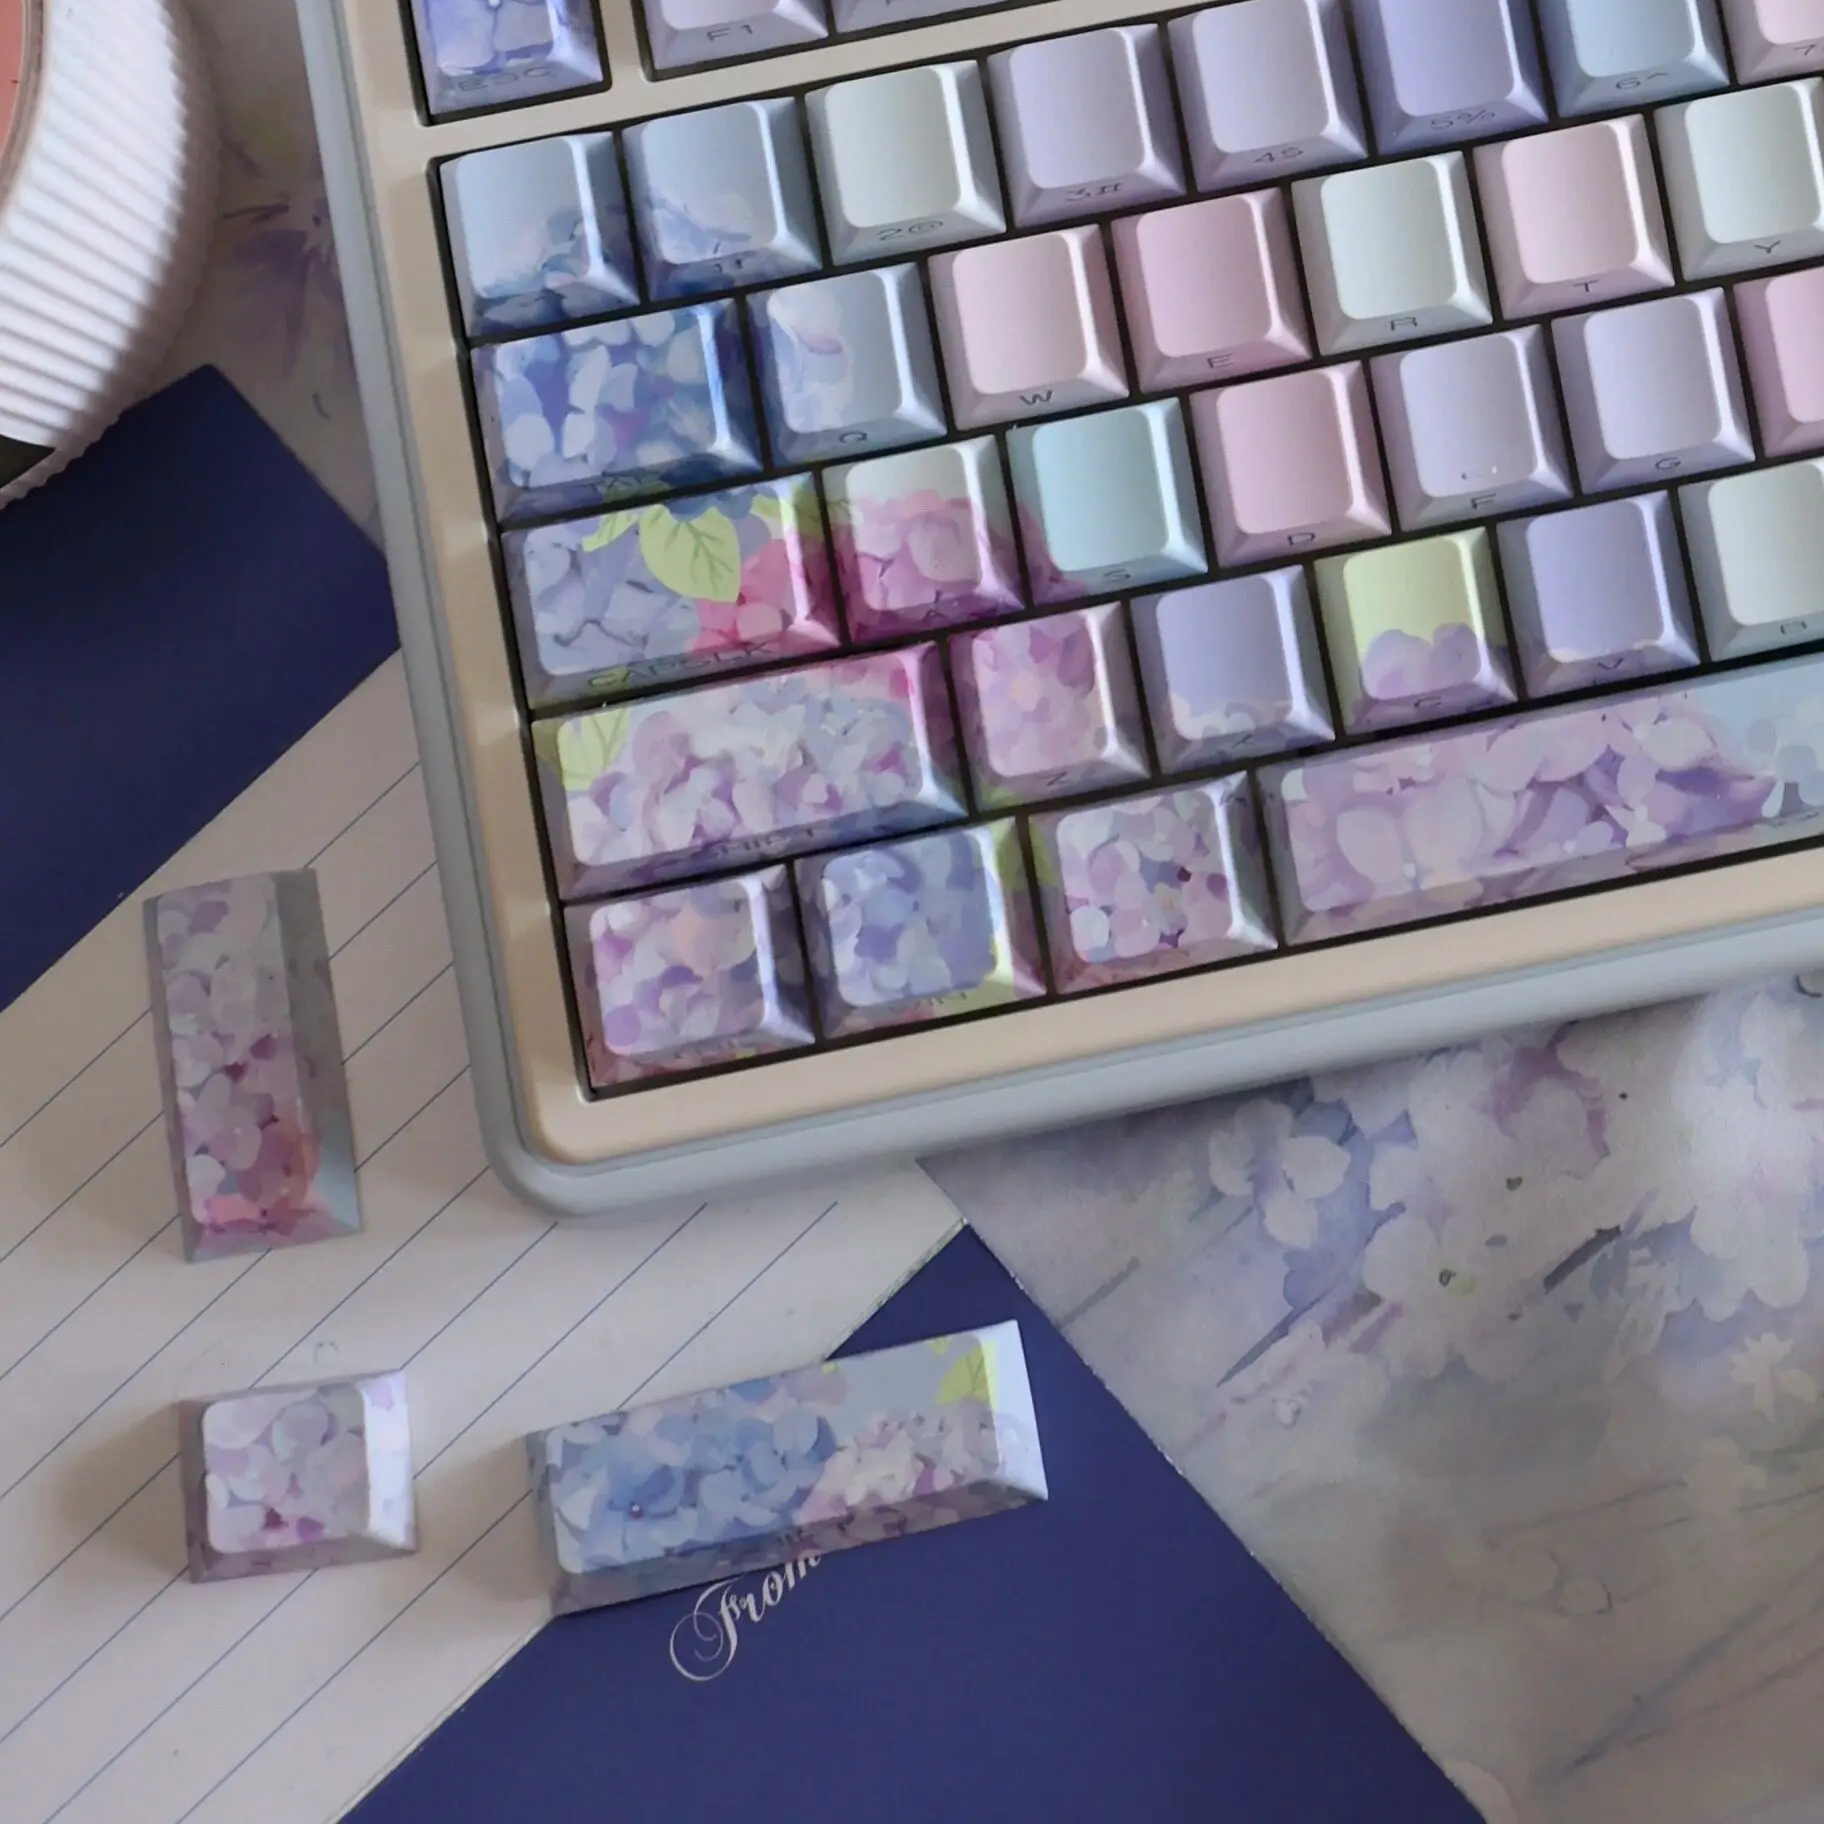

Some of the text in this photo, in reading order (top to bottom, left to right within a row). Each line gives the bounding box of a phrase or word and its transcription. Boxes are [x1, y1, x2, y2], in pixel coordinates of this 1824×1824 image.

[707, 23, 753, 44] F1
[1753, 239, 1783, 256] Y
[1573, 279, 1600, 294] T
[1389, 315, 1419, 333] R
[1207, 354, 1234, 371] E
[1019, 389, 1055, 407] W
[838, 428, 869, 446] Q
[1653, 455, 1682, 473] G
[1469, 491, 1499, 510] F
[1287, 530, 1315, 546] D
